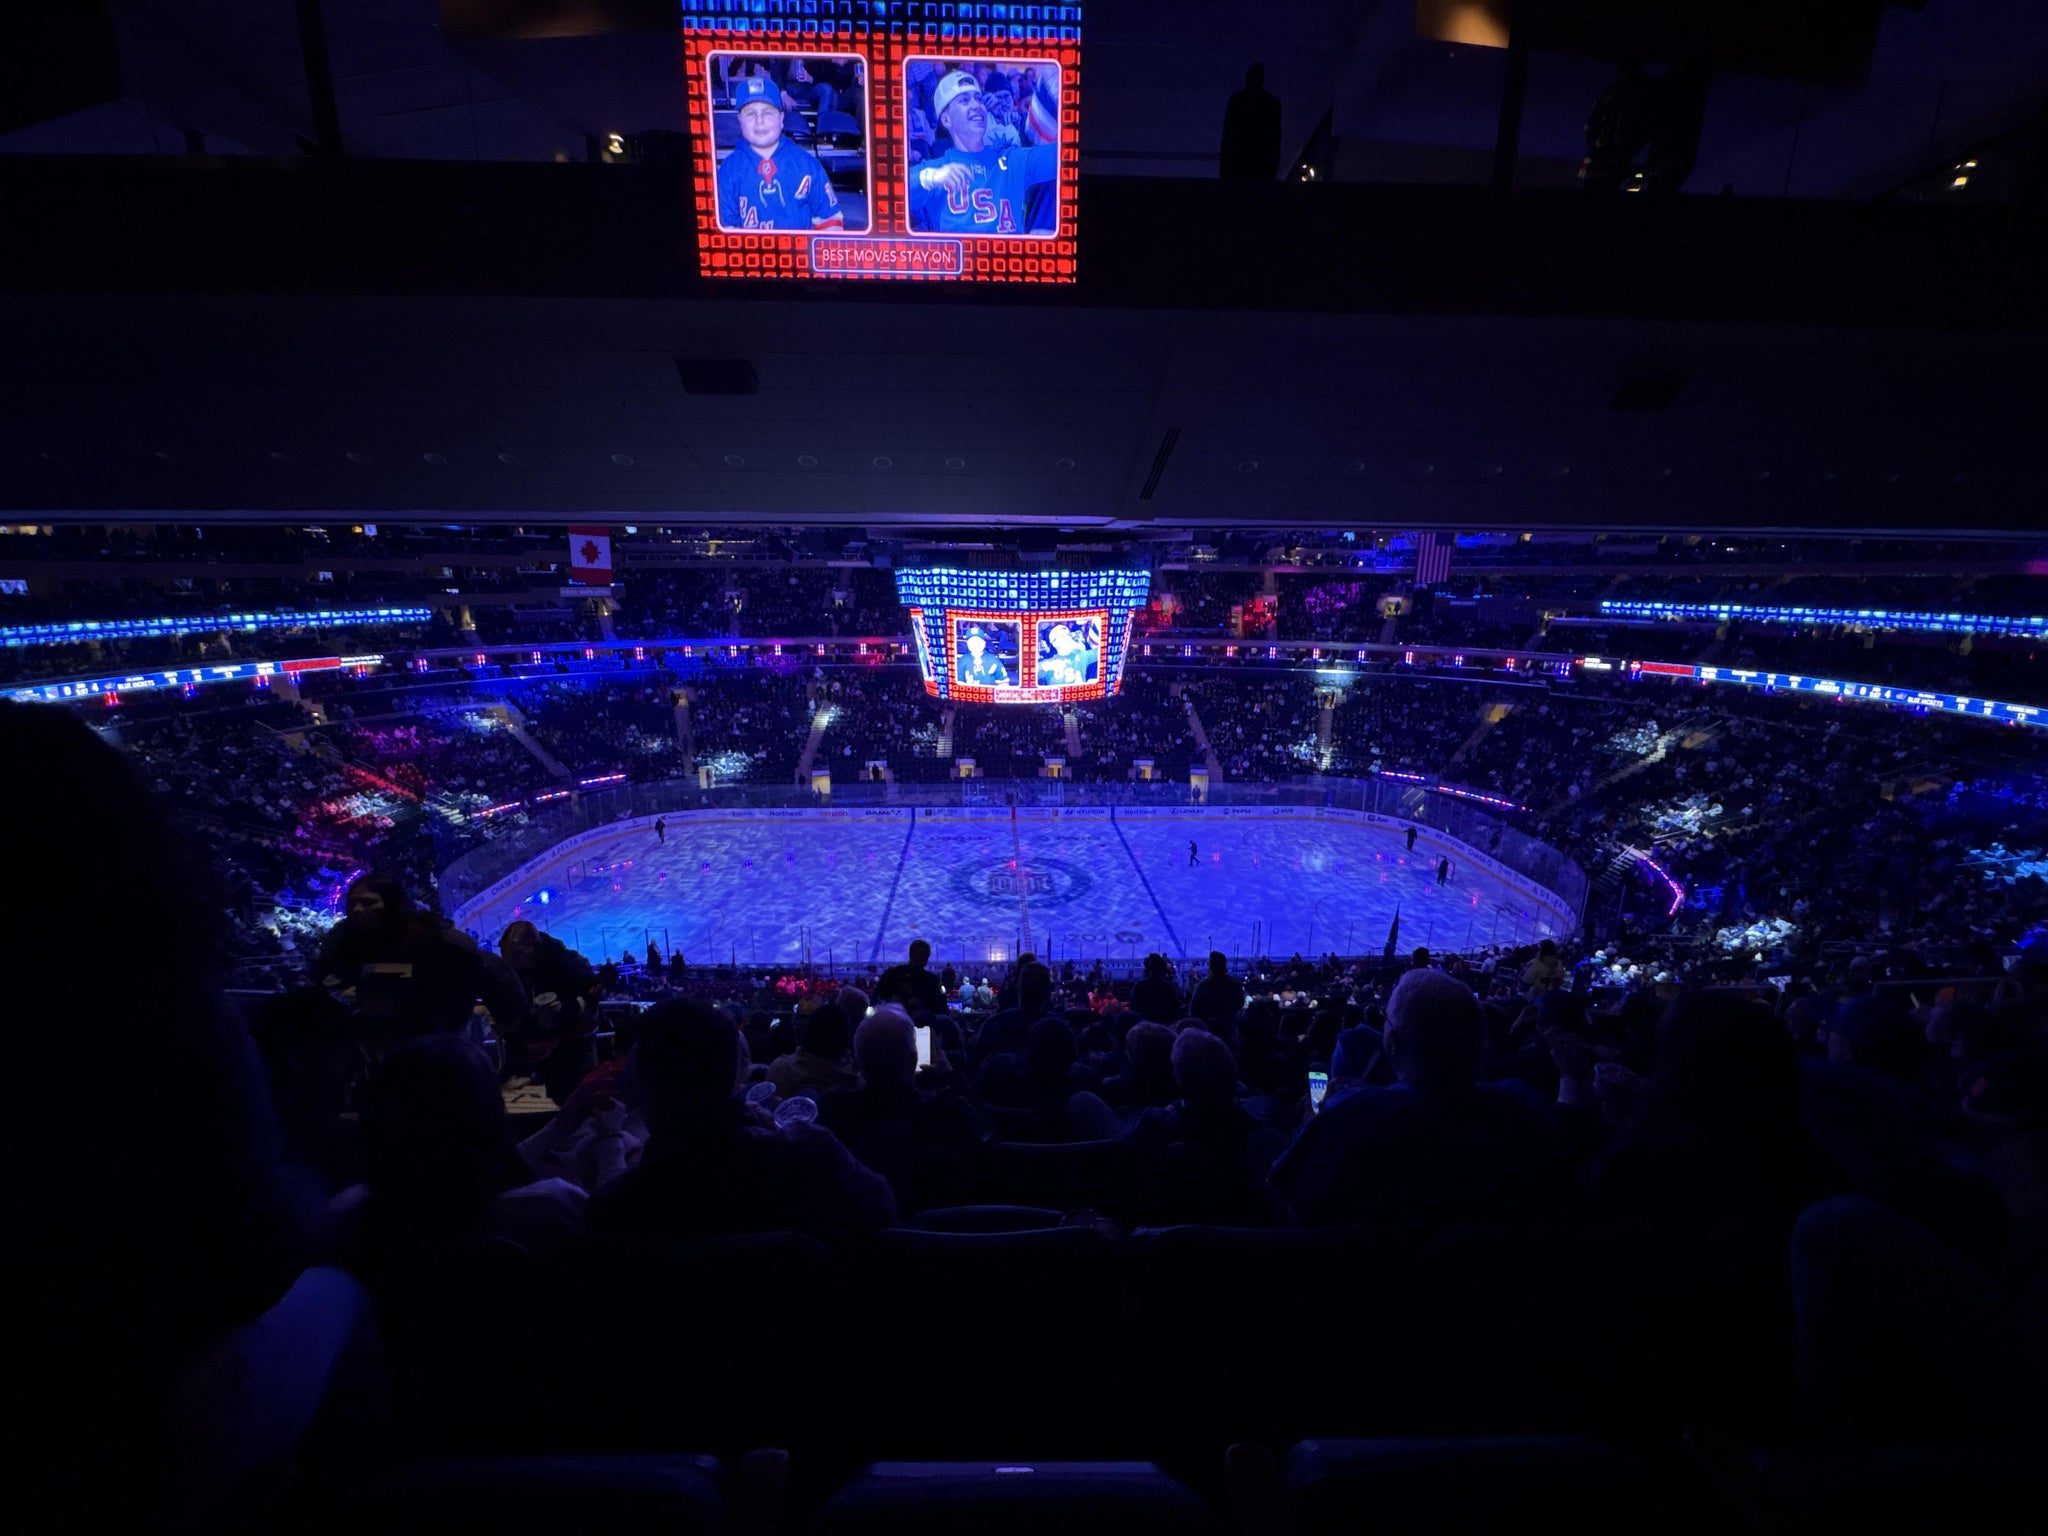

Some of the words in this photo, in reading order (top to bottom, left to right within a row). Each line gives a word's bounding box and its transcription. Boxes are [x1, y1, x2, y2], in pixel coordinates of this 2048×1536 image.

[794, 174, 812, 200] A
[944, 180, 1017, 233] USA
[822, 249, 850, 261] BEST
[854, 249, 897, 262] MOVES
[900, 250, 929, 262] STAY
[932, 251, 951, 263] ON
